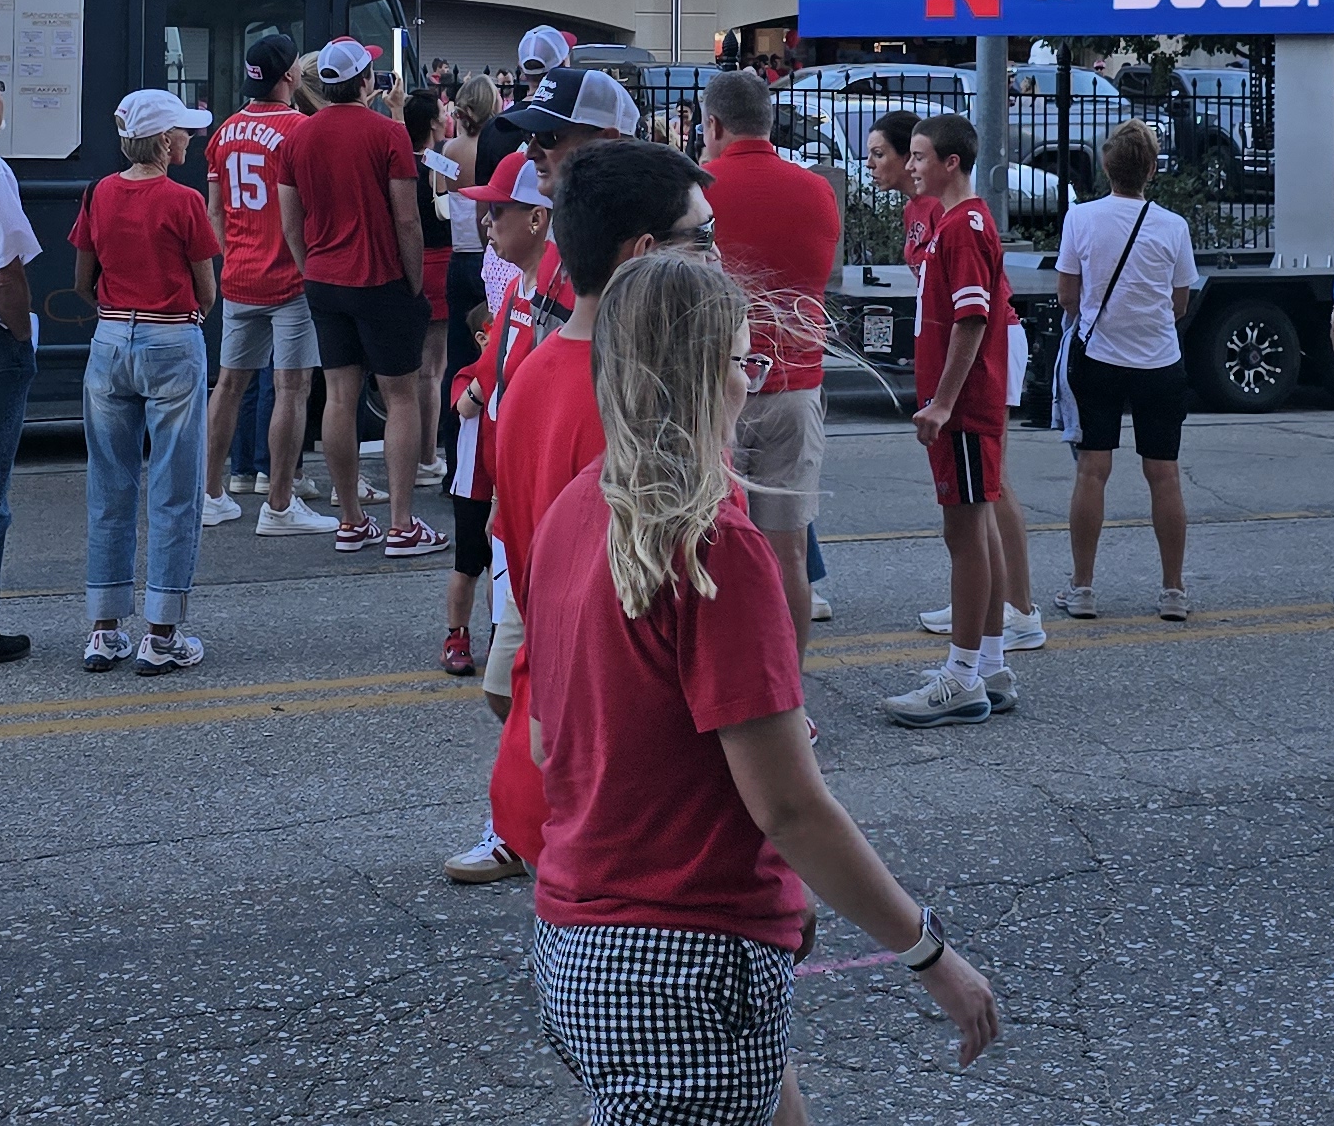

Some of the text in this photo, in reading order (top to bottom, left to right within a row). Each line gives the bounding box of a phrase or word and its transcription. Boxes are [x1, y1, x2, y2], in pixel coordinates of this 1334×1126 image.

[218, 121, 285, 152] JACKSON
[225, 151, 268, 211] 15
[967, 210, 985, 232] 3
